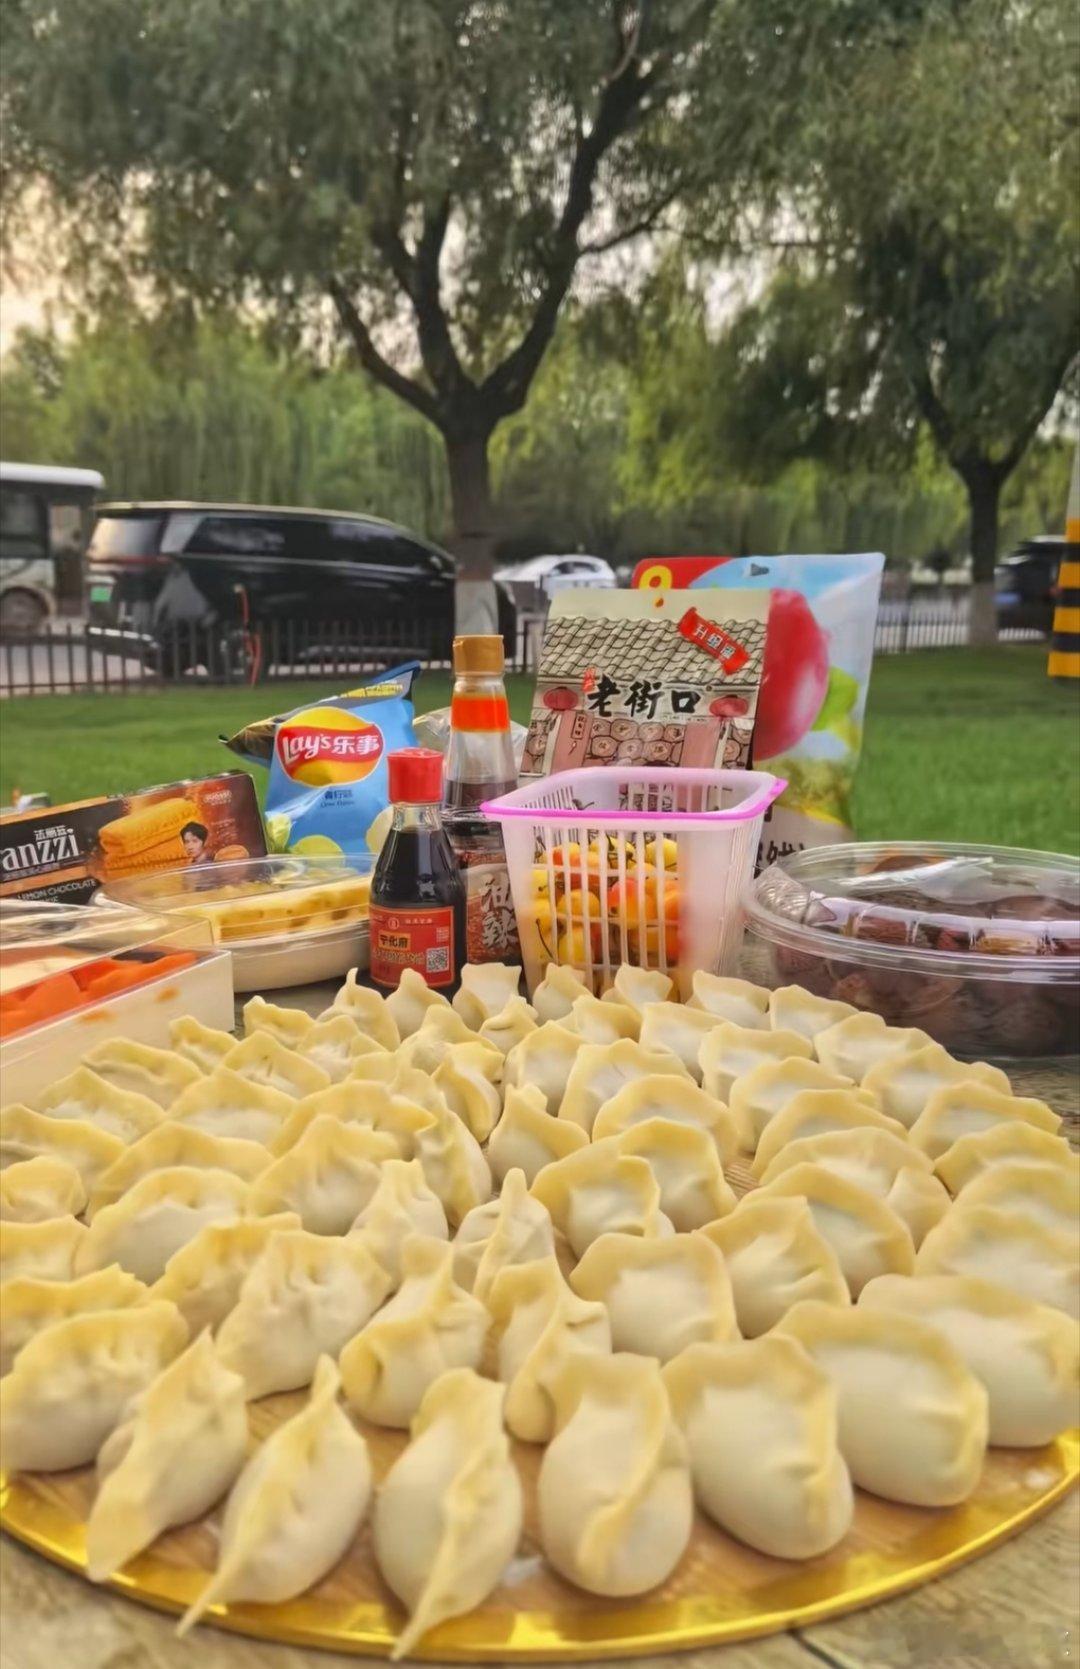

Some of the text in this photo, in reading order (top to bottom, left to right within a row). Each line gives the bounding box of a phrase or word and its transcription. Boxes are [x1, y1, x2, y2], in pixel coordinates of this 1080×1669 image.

[587, 673, 701, 720] 老街口
[282, 733, 380, 765] Lay's 乐事
[48, 879, 96, 895] CHOCOLATE
